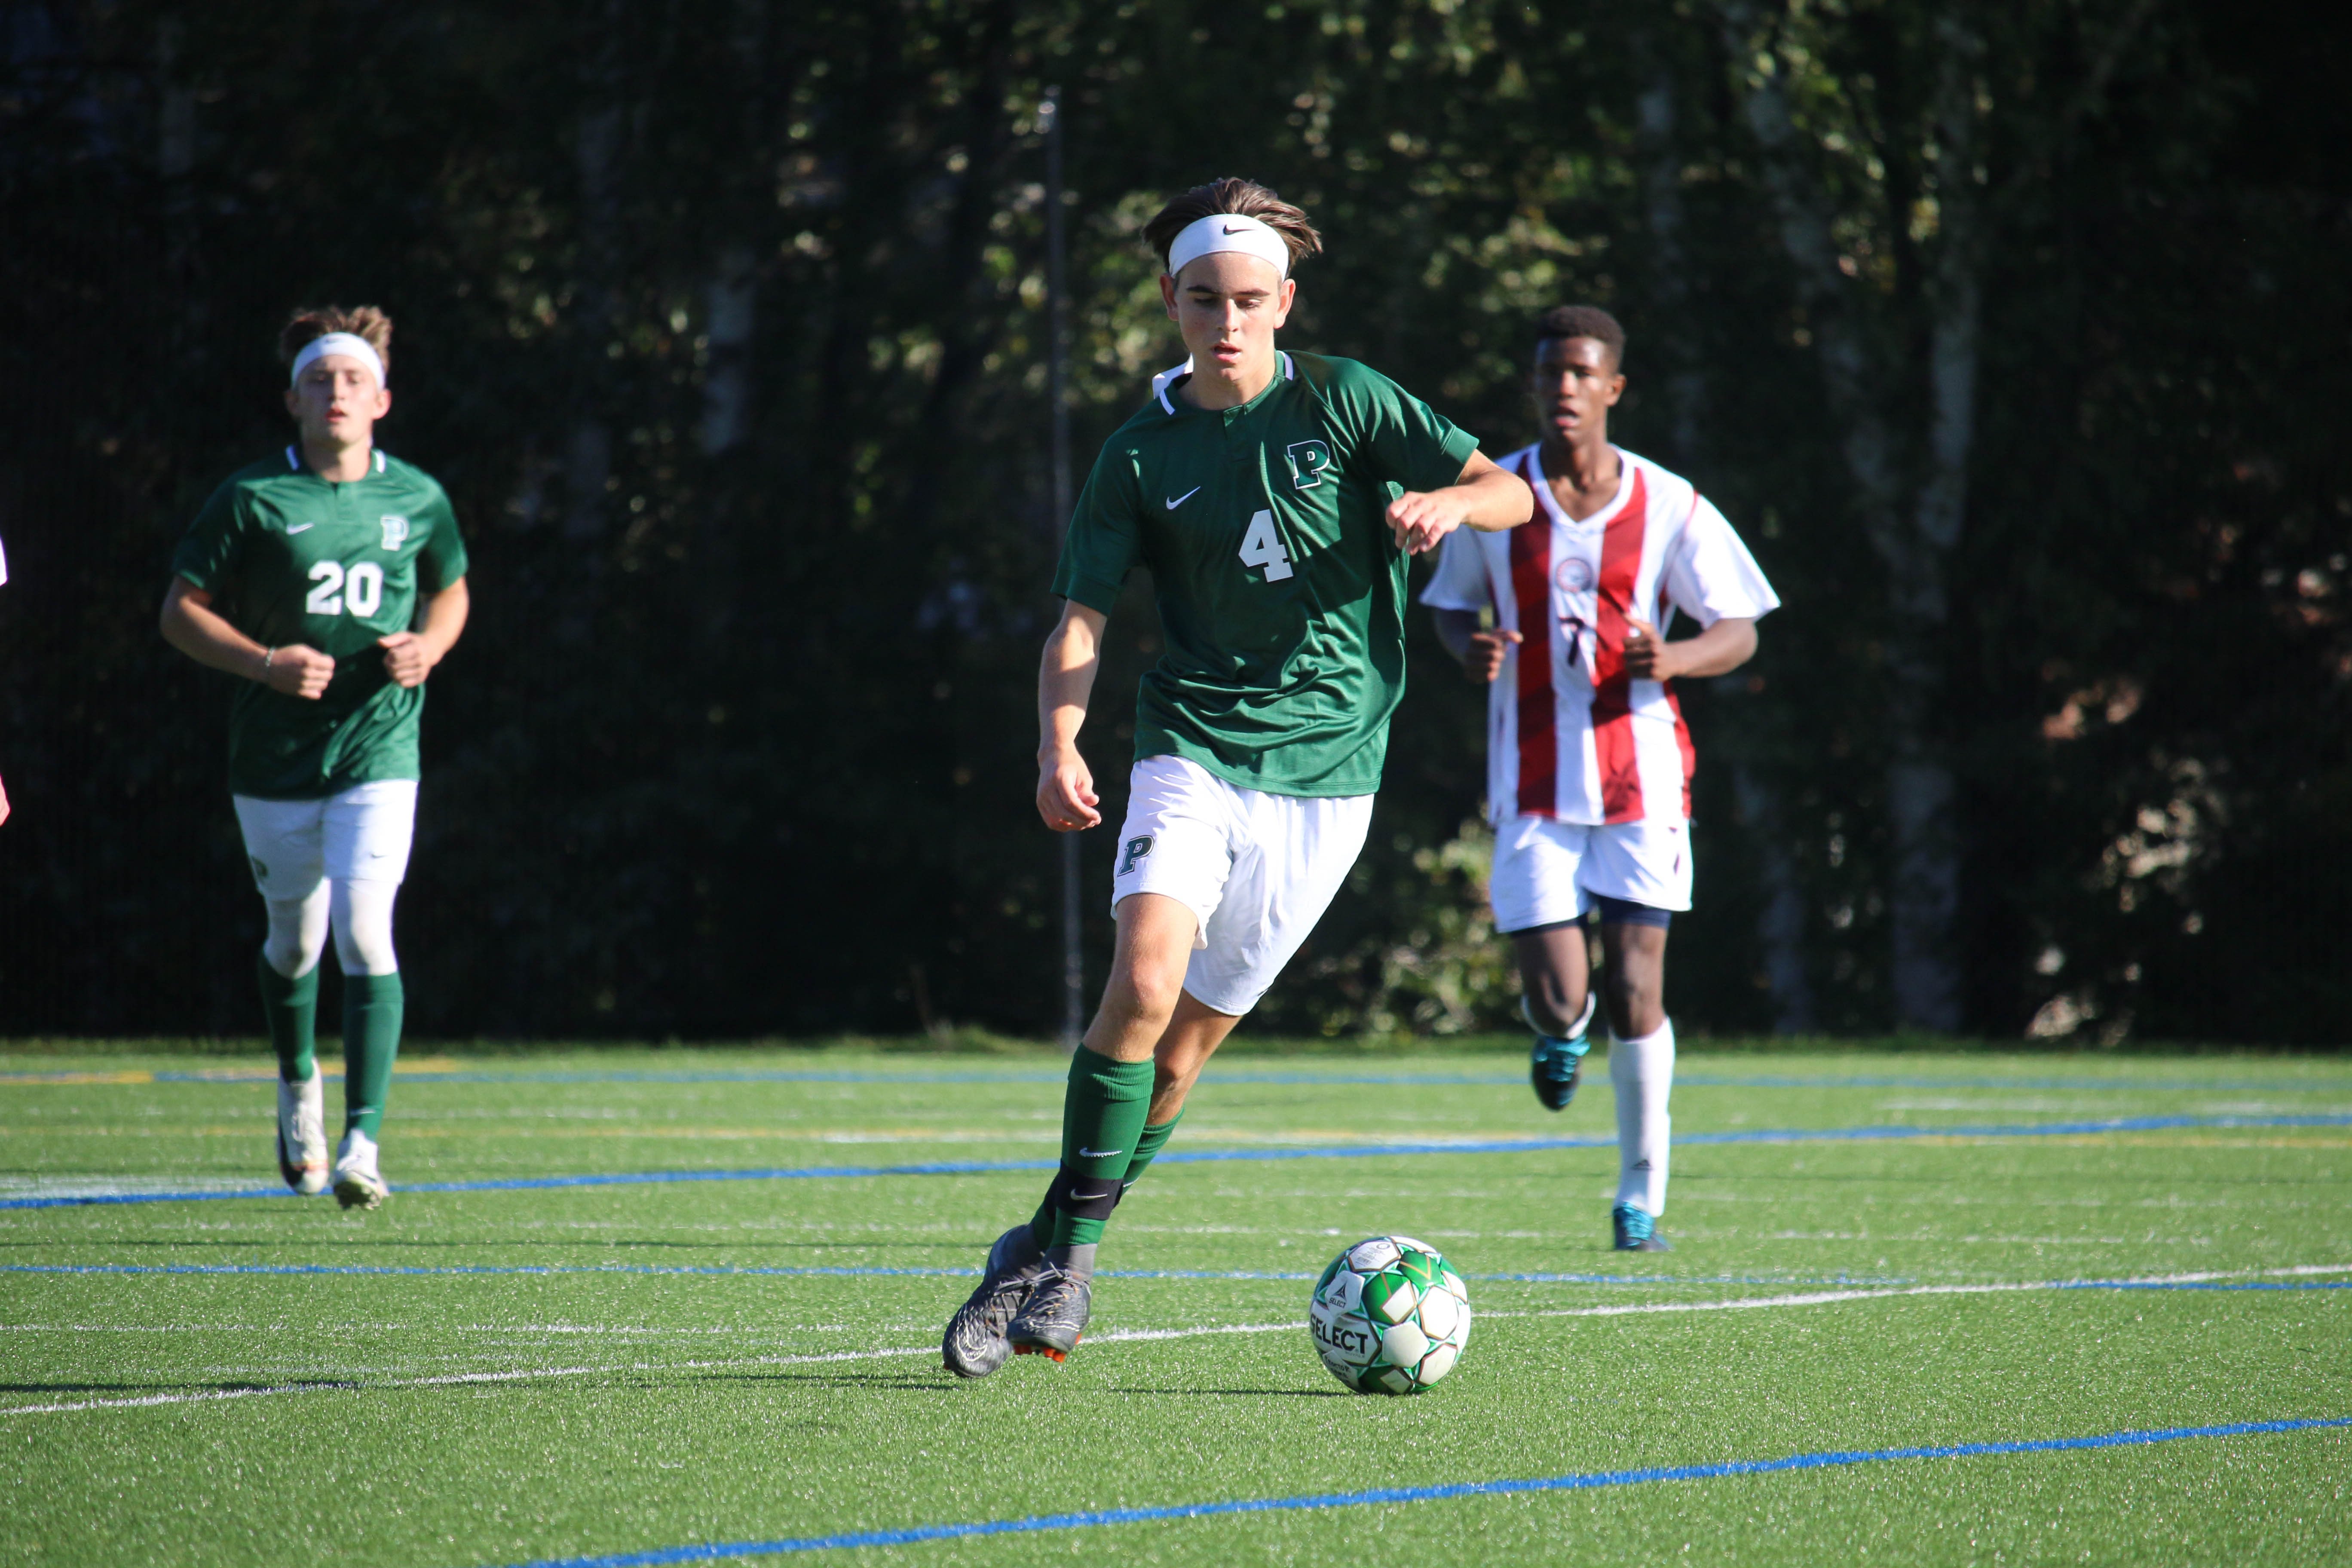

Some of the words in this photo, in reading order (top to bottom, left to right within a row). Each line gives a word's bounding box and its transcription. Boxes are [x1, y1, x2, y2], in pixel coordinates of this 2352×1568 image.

[1287, 440, 1330, 490] P
[380, 515, 409, 551] P
[1238, 509, 1294, 582] 4
[306, 560, 384, 617] 20
[1117, 835, 1155, 877] P
[1329, 1297, 1346, 1308] SELECT
[1311, 1313, 1368, 1354] SELECT
